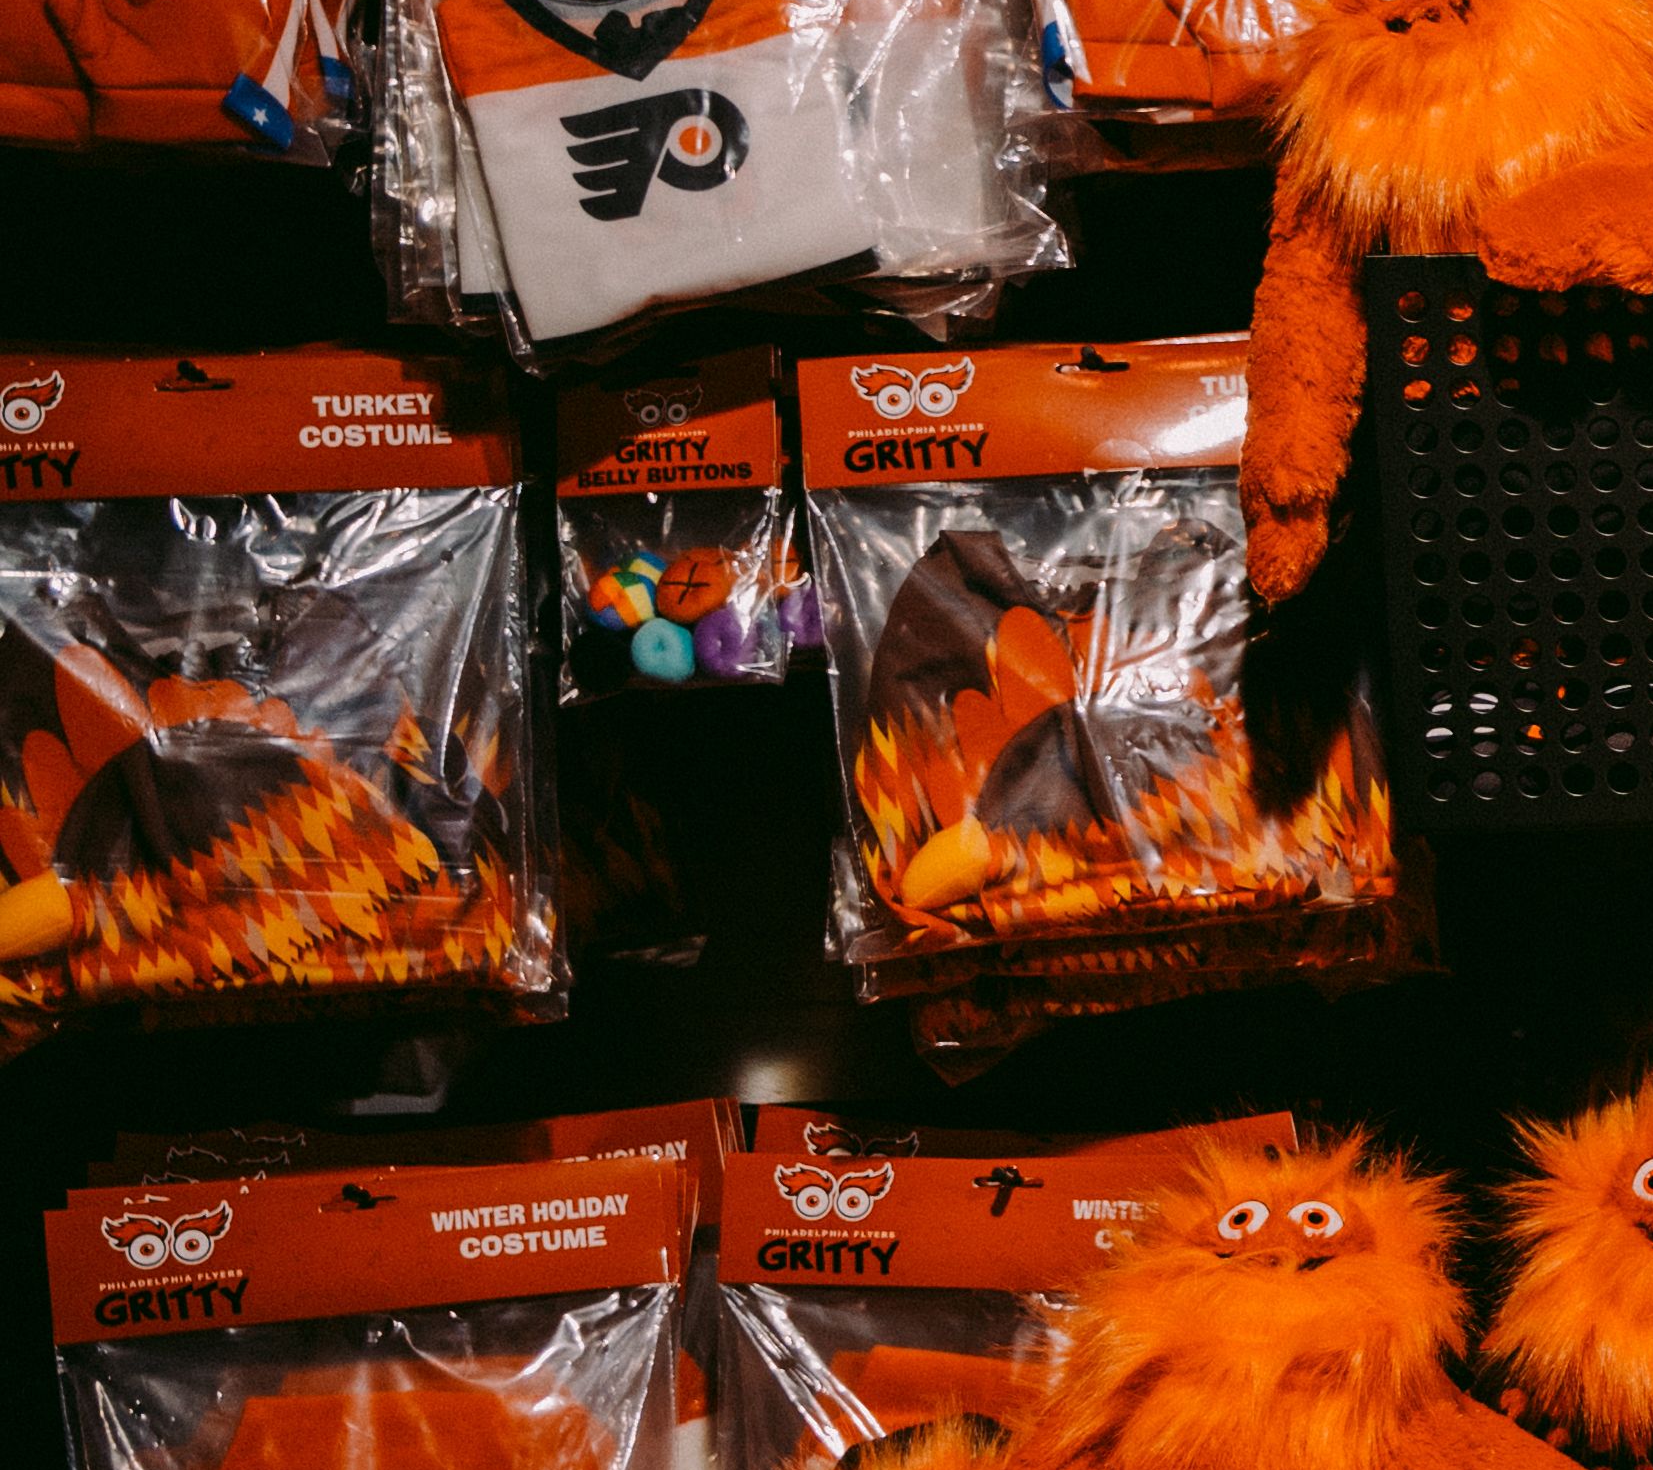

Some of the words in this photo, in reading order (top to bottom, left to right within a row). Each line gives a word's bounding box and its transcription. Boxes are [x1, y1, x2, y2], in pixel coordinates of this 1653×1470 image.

[312, 393, 434, 418] TURKEY
[299, 423, 453, 448] COSTUME
[848, 426, 937, 440] PHILADELPHIA
[939, 422, 985, 434] FLYERS
[615, 436, 711, 465] GRITTY
[844, 433, 990, 473] GRITTY
[577, 467, 641, 488] BELLY
[646, 462, 754, 484] BUTTONS
[431, 1203, 525, 1232] WINTER
[532, 1193, 630, 1222] HOLIDAY
[459, 1226, 608, 1260] COSTUME
[757, 1238, 900, 1274] GRITTY
[99, 1274, 193, 1292] PHILADELPHIA
[197, 1269, 245, 1282] FLYERS
[94, 1278, 248, 1327] GRITTY
